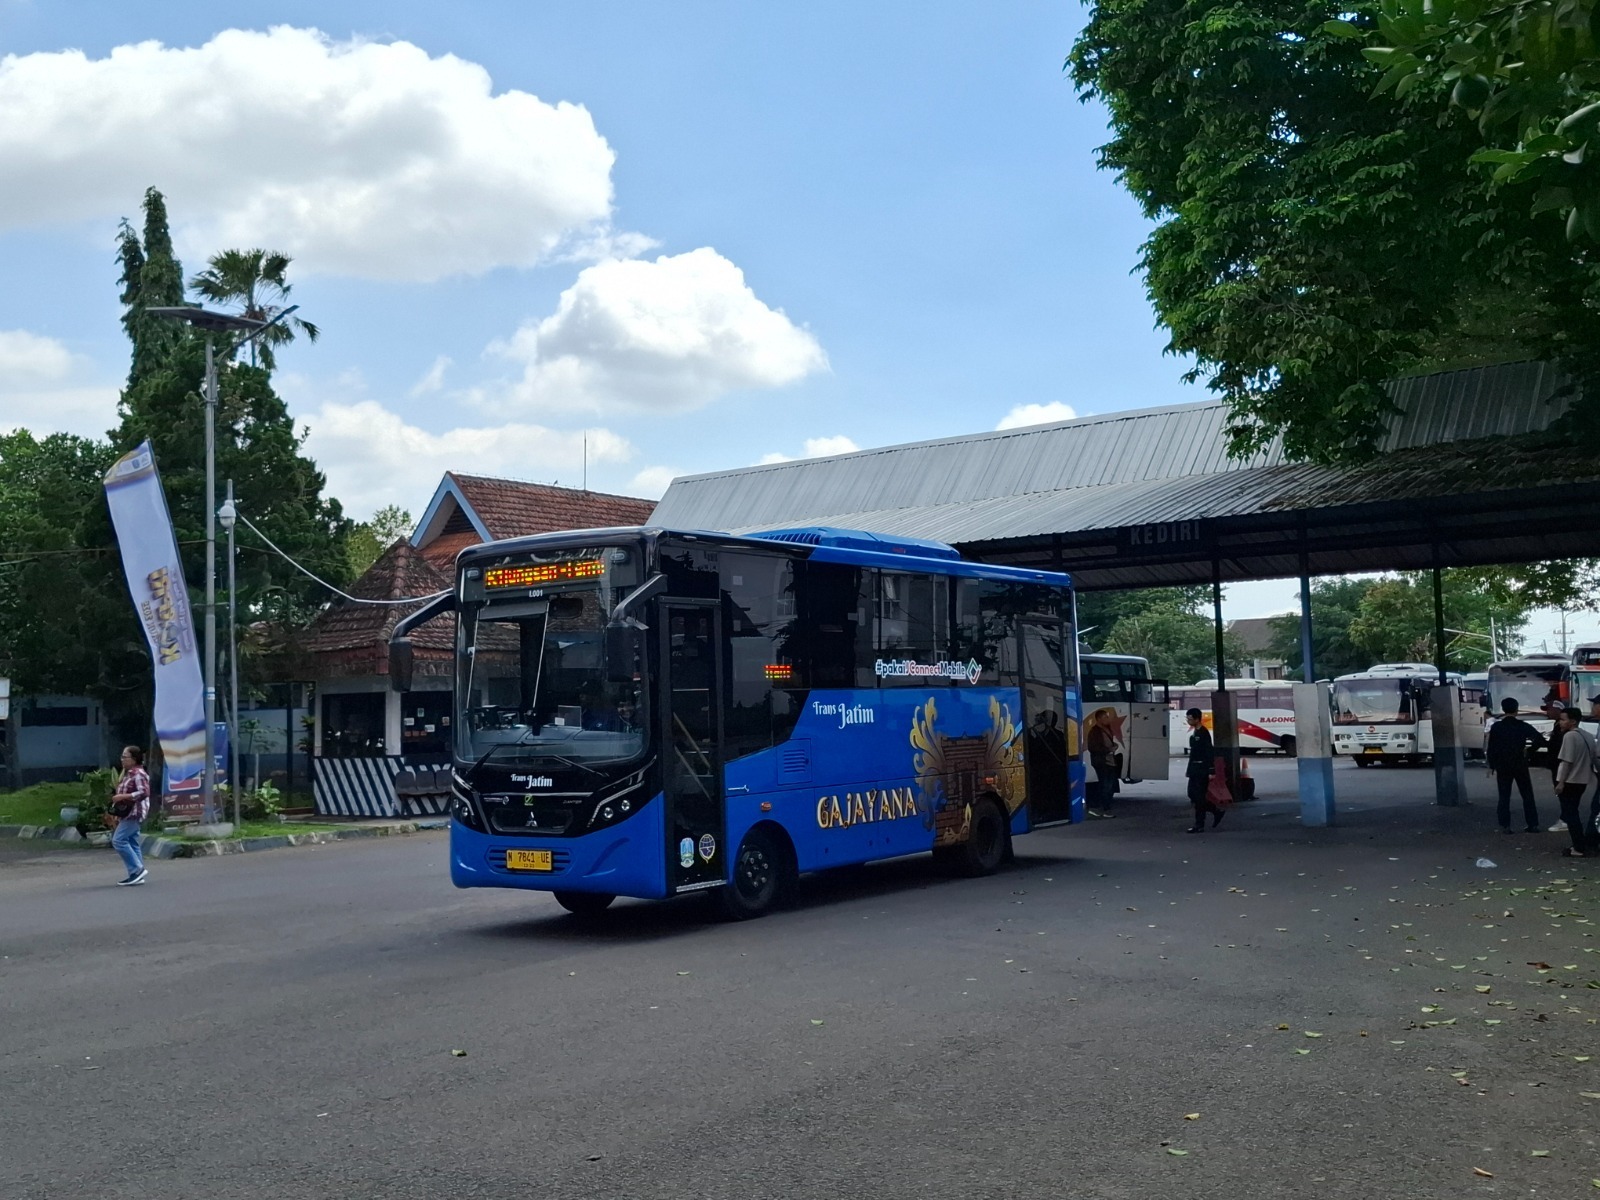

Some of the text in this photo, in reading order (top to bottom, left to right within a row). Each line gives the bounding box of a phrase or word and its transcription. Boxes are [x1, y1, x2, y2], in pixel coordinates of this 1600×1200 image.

[1130, 521, 1200, 545] KEDIRI
[529, 589, 543, 598] L001
[812, 701, 875, 729] Trans Jatim
[510, 774, 553, 789] Trans Jatim
[817, 786, 918, 829] GAJAYANA
[507, 851, 550, 864] N 7841 UE
